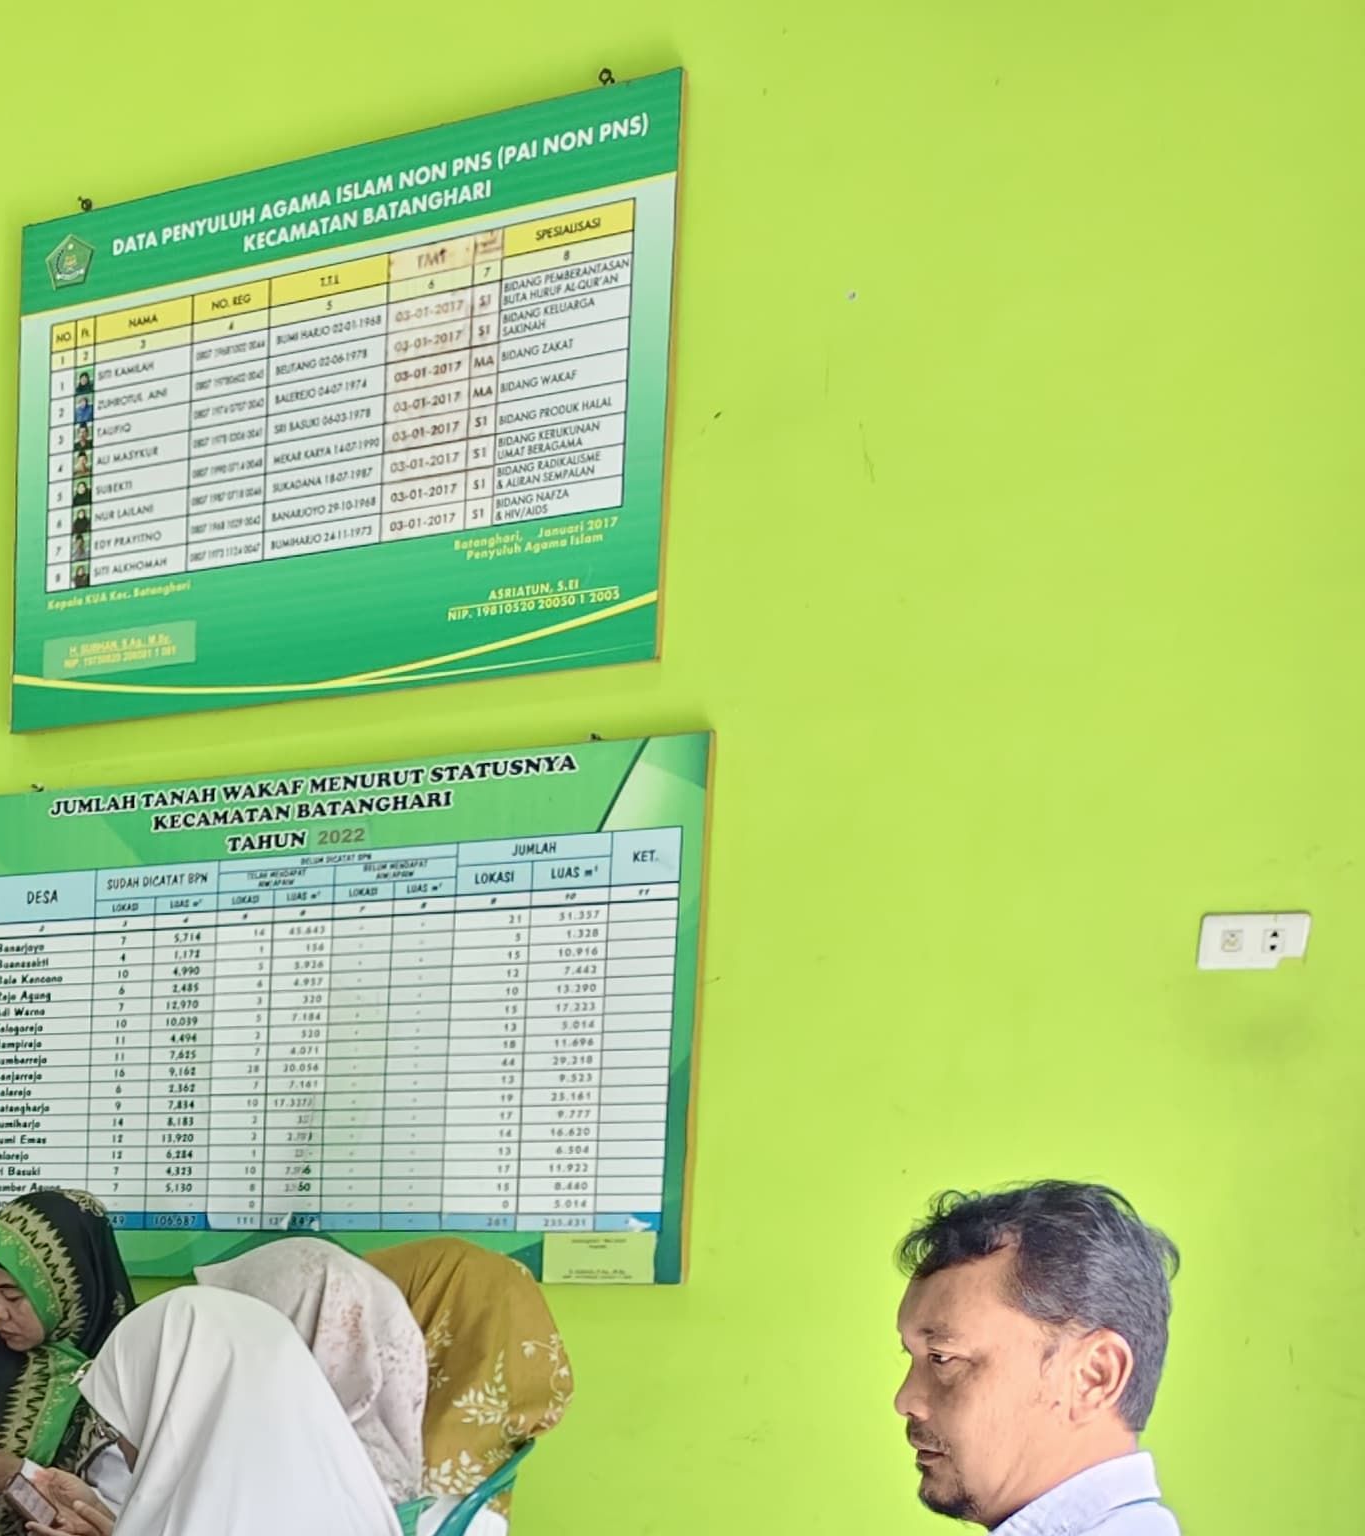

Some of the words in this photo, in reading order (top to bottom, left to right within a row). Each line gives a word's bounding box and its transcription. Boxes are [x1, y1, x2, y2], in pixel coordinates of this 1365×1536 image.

[112, 232, 158, 256] DATA
[161, 207, 255, 245] PENYULUH
[259, 190, 331, 222] AGAMA
[336, 176, 394, 204] ISLAM
[399, 162, 448, 190] NON
[452, 151, 492, 177] PNS
[497, 140, 538, 170] (PAI
[543, 127, 594, 155] NON
[599, 112, 649, 143] PNS)
[243, 210, 358, 253] KECAMATAN
[363, 180, 492, 225] BATANGHARI
[535, 217, 602, 242] SPESIALISASI
[483, 266, 491, 278] 7
[504, 275, 542, 293] BIDANG
[544, 259, 630, 286] PEMBERANTASAN
[232, 294, 252, 306] REG
[503, 294, 528, 306] BUTA
[530, 285, 563, 301] HURUF
[395, 299, 464, 323] 03-01-2017
[503, 307, 541, 323] BIDANG
[543, 297, 595, 315] KELUARGA
[128, 314, 159, 328] NAMA
[503, 320, 546, 337] SAKINAH
[394, 329, 463, 353] 03-01-2017
[501, 345, 539, 361] BIDANG
[542, 338, 574, 353] ZAKAT
[393, 360, 462, 383] 03-01-2017
[474, 355, 495, 368] MA
[500, 377, 538, 393] BIDANG
[540, 369, 577, 384] WAKAF
[393, 390, 462, 413] 03-01-2017
[473, 385, 493, 399] MA
[474, 415, 488, 427] S1
[499, 409, 537, 425] BIDANG
[539, 402, 580, 418] PRODUK
[582, 396, 612, 410] HALAL
[274, 423, 287, 434] SRI
[289, 417, 319, 431] BASUKI
[392, 421, 460, 443] 03-01-2017
[498, 432, 536, 448] BIDANG
[538, 421, 600, 440] KERUKUNAN
[96, 454, 111, 465] ALI
[113, 446, 158, 463] MASYKUR
[473, 447, 487, 459] S1
[497, 446, 526, 460] UMAT
[527, 437, 583, 455] BERAGAMA
[390, 451, 460, 473] 03-01-2017
[497, 462, 535, 477] BIDANG
[537, 451, 601, 470] RADIKALISME
[273, 476, 322, 494] SUKADANA
[473, 478, 486, 490] S1
[505, 474, 541, 488] ALIRAN
[543, 465, 595, 482] SEMPALAN
[95, 481, 133, 495] SUBEKTI
[390, 482, 458, 503] 03-01-2017
[496, 494, 534, 509] BIDANG
[536, 488, 570, 502] NAFZA
[95, 510, 116, 522] NUR
[271, 504, 327, 523] BANARJOYO
[389, 512, 456, 532] 03-01-2017
[472, 508, 485, 519] S1
[504, 504, 549, 520] HIV/AIDS
[94, 538, 112, 551] EDY
[114, 531, 162, 547] PRAYITNO
[454, 531, 523, 550] Batanghari,
[538, 522, 584, 538] Januari
[587, 516, 618, 531] 2017
[466, 542, 521, 560] Penyuluh
[524, 537, 567, 554] Agama
[570, 533, 604, 546] Islam
[112, 558, 168, 575] ALKHOMAH
[488, 582, 553, 601] ASRIATUN,
[557, 578, 579, 592] S.EI
[447, 609, 473, 622] NIP.
[476, 600, 535, 617] 19810520
[538, 595, 575, 610] 20050
[580, 593, 585, 604] 1
[589, 589, 620, 603] 2005
[51, 795, 135, 815] JUMLAH
[141, 788, 216, 808] TANAH
[222, 780, 304, 800] WAKAF
[310, 769, 424, 793] MENURUT
[430, 755, 576, 783] STATUSNYA
[153, 805, 290, 831] KECAMATAN
[297, 791, 452, 818] BATANGHARI
[228, 832, 306, 852] TAHUN
[318, 828, 365, 845] 2022
[512, 842, 556, 856] JUMLAH
[107, 878, 139, 889] SUDAH
[143, 876, 184, 887] DICATAT
[188, 873, 208, 884] BPN
[475, 871, 514, 884] LOKASI
[551, 867, 579, 879] LUAS
[27, 890, 59, 904] DESA
[21, 991, 51, 1003] Agung
[8, 1167, 41, 1176] Basuki
